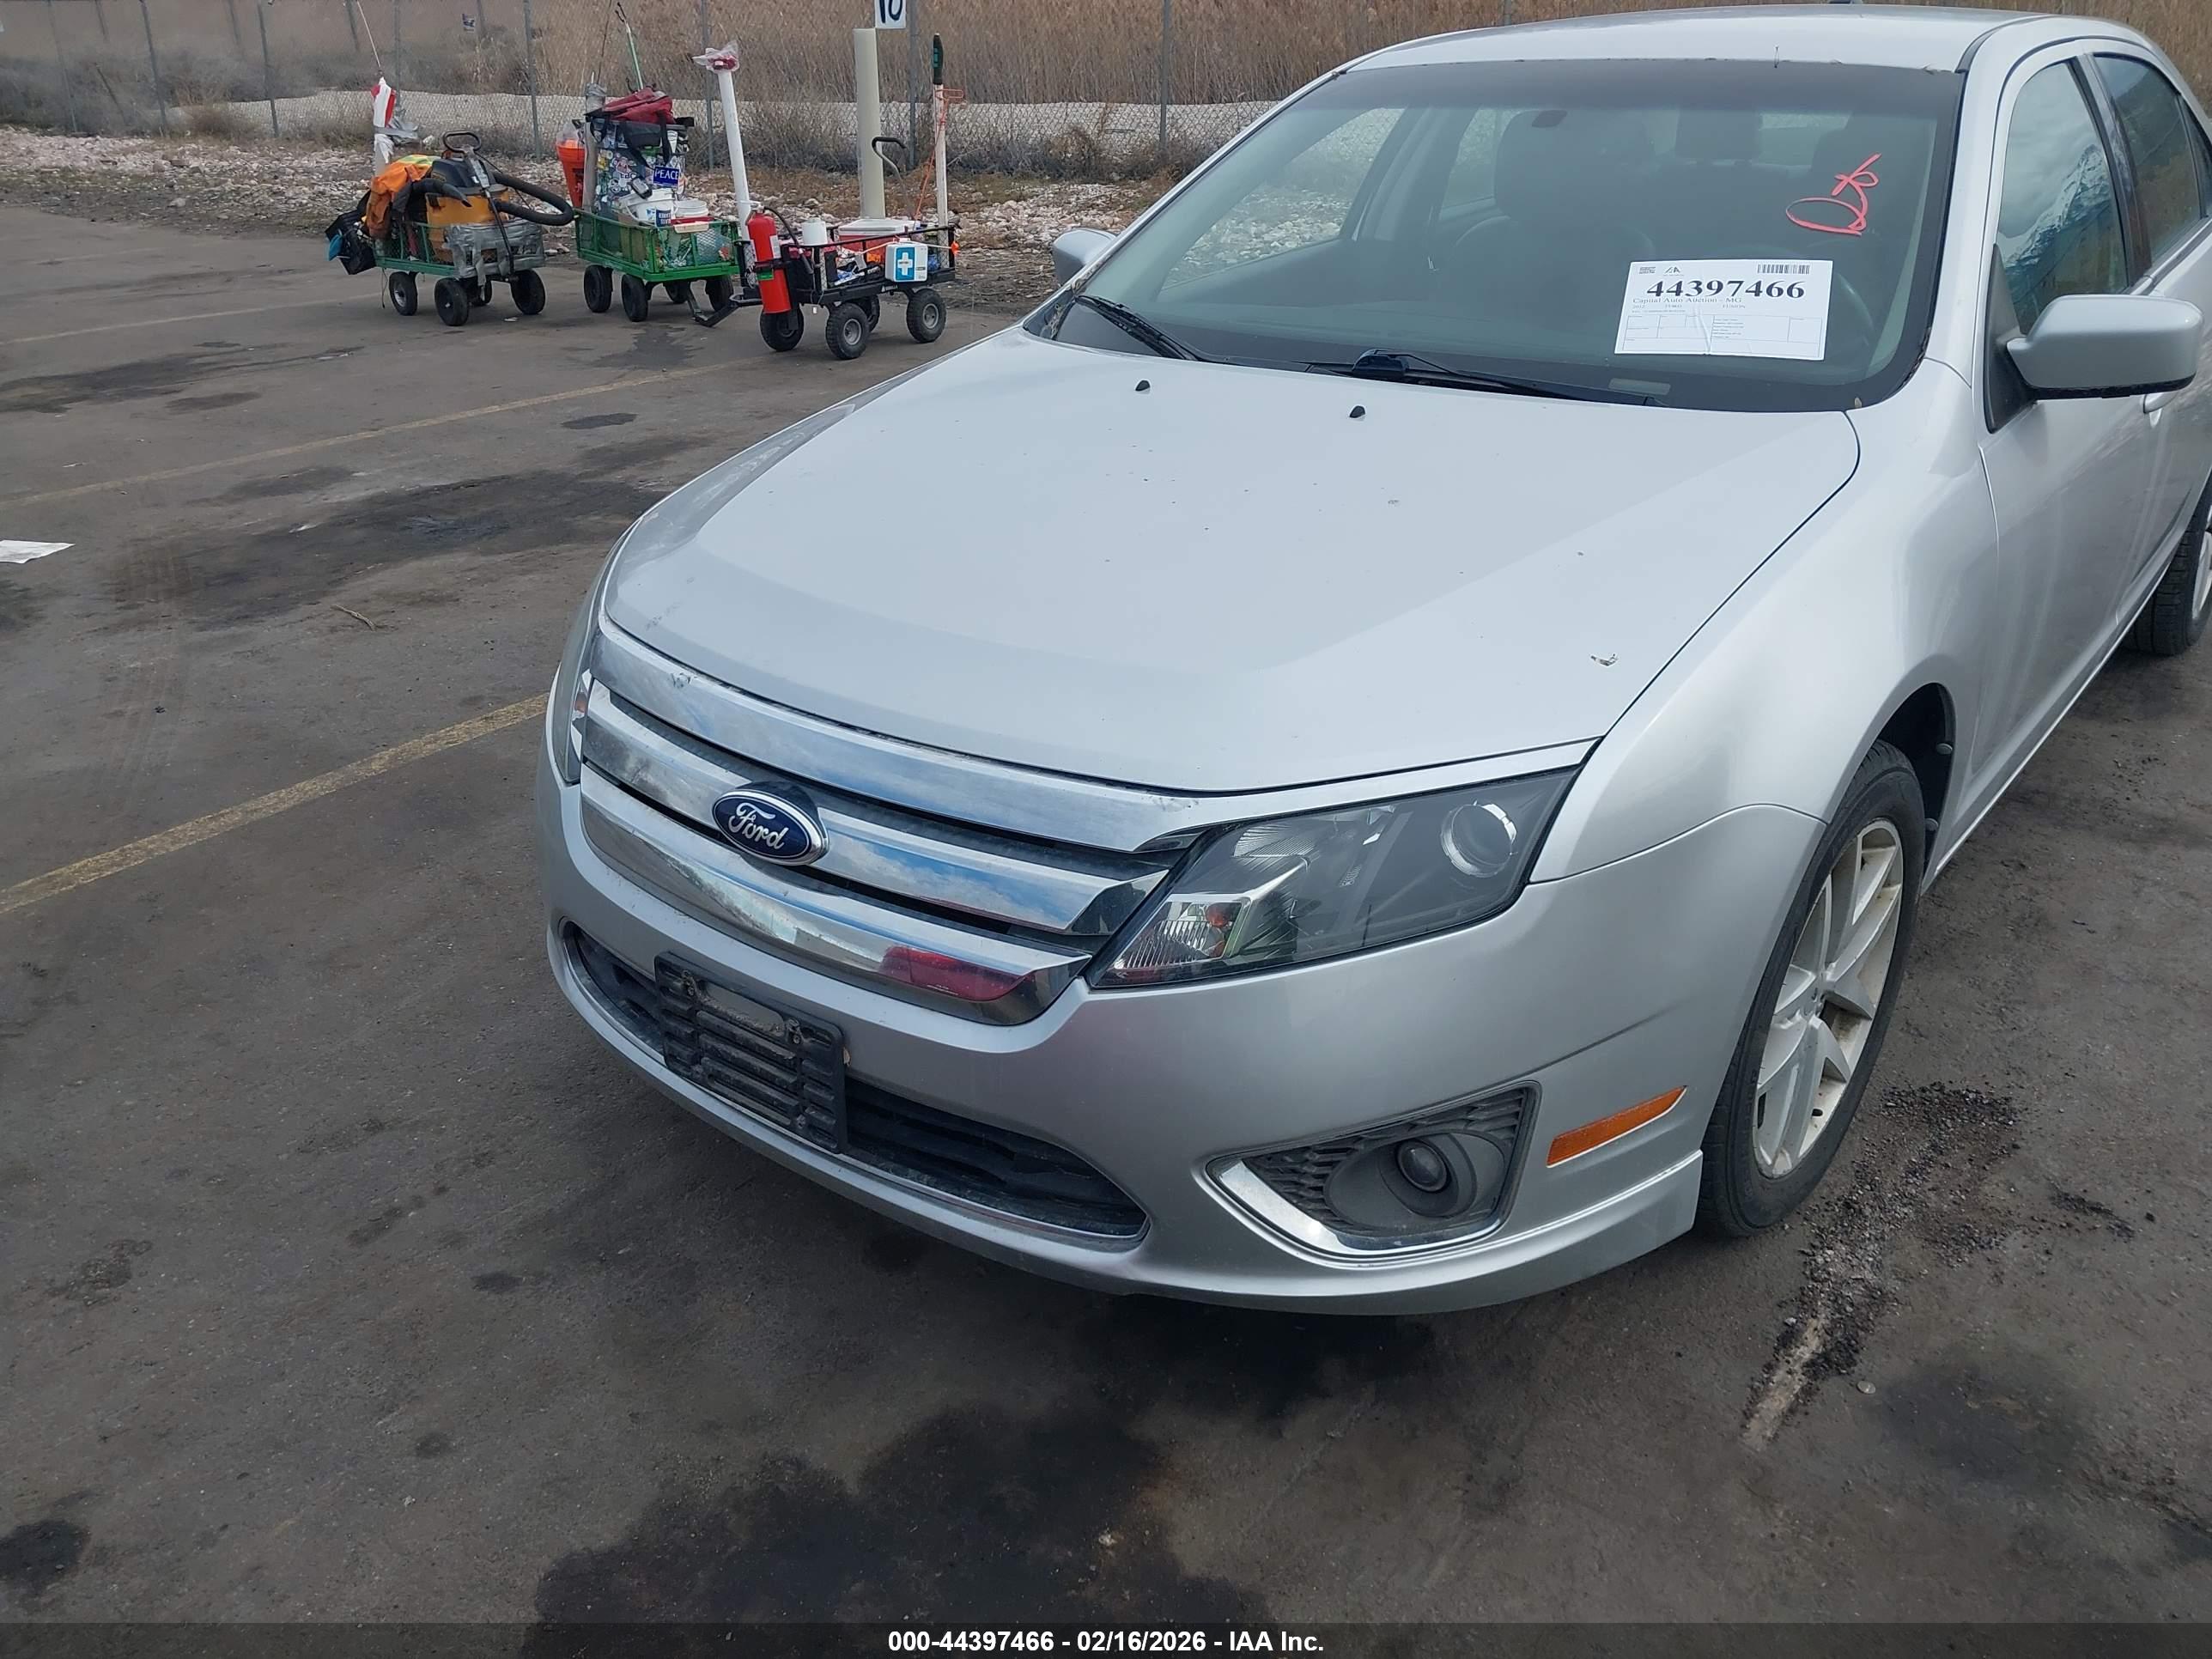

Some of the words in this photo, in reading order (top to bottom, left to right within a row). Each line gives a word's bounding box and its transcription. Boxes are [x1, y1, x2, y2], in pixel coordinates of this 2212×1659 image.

[878, 0, 903, 24] 10
[654, 168, 678, 180] PEACE
[1646, 280, 1805, 299] 44397466
[728, 802, 789, 850] Ford
